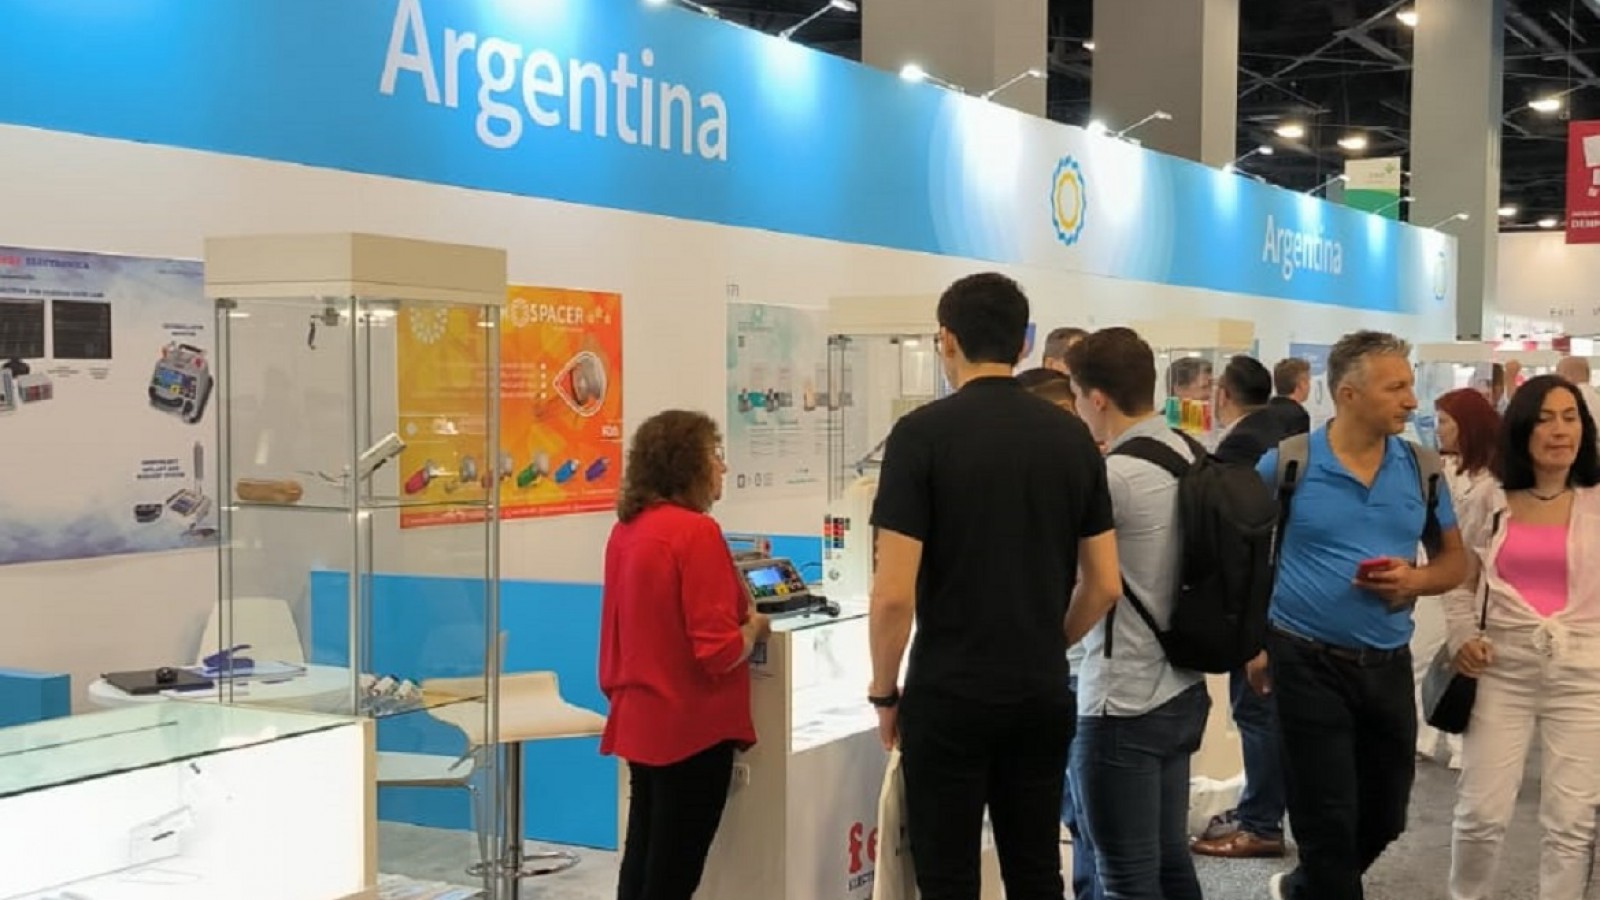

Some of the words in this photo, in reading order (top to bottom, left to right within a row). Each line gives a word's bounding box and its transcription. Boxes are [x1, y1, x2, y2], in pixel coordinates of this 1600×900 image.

[379, 0, 727, 161] Argentina
[1262, 214, 1342, 280] Argentina
[529, 303, 584, 325] SPACER
